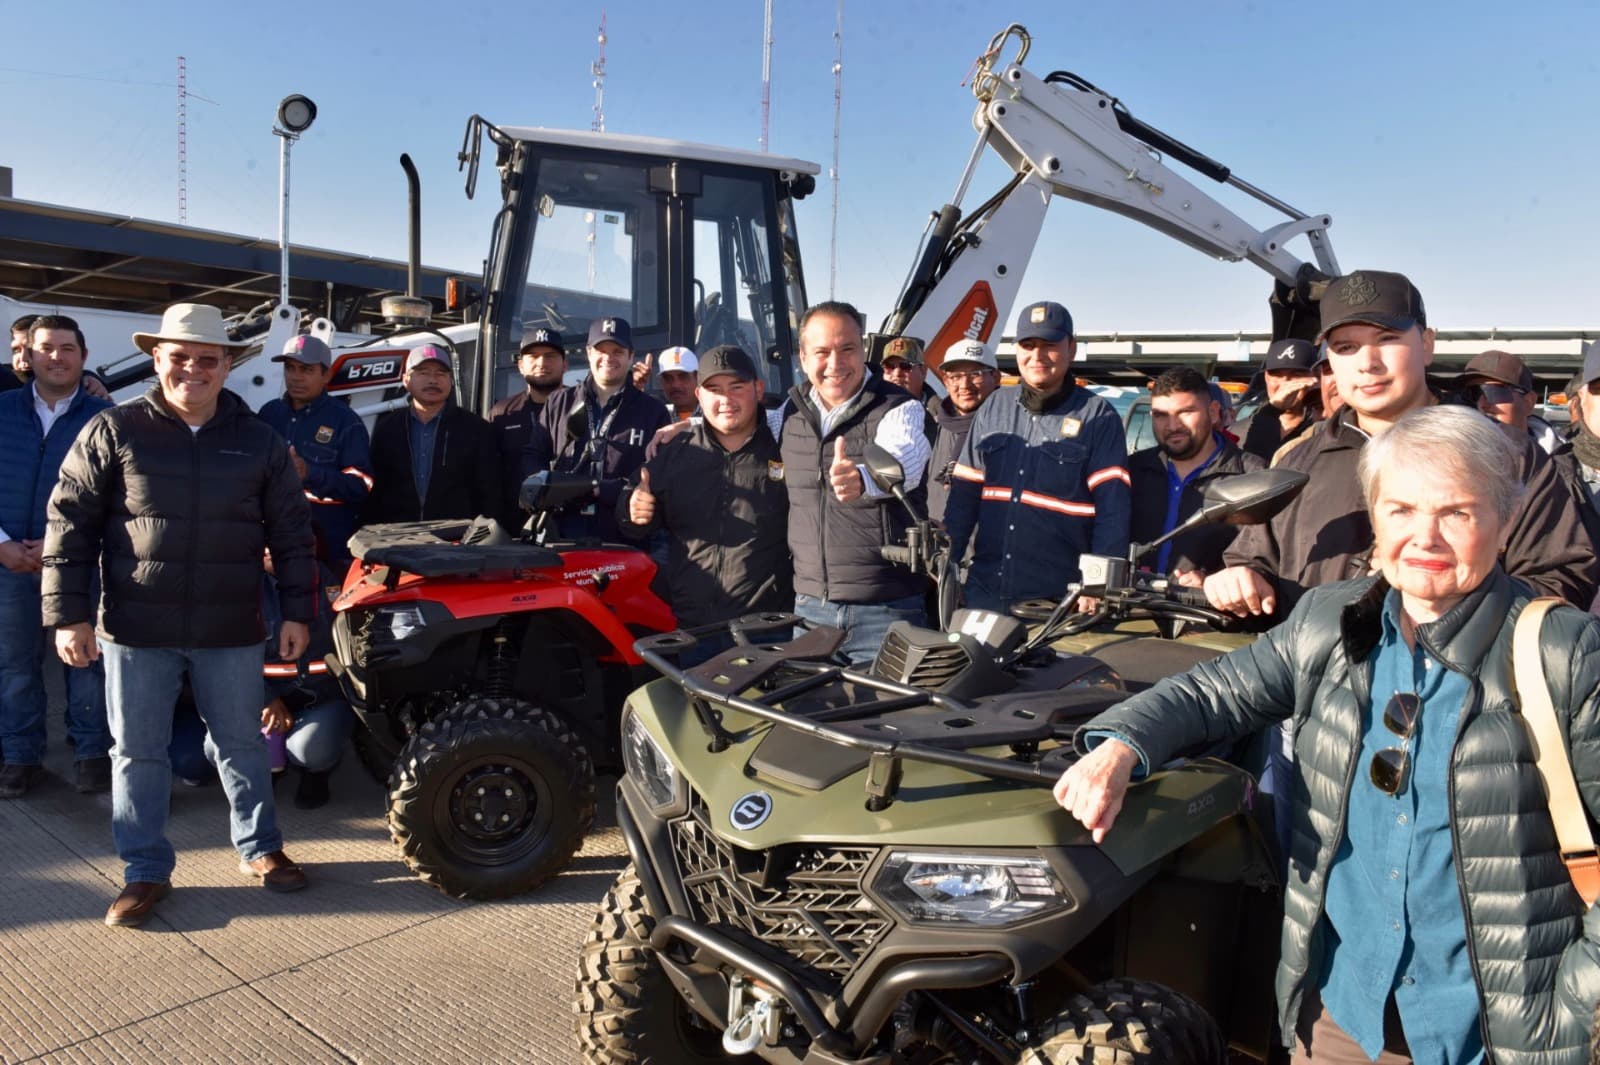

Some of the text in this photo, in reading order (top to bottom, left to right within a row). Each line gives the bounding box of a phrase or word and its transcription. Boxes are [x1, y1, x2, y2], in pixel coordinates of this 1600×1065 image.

[602, 320, 616, 333] H
[963, 306, 988, 340] bcat
[1277, 344, 1295, 359] A
[629, 428, 644, 446] H
